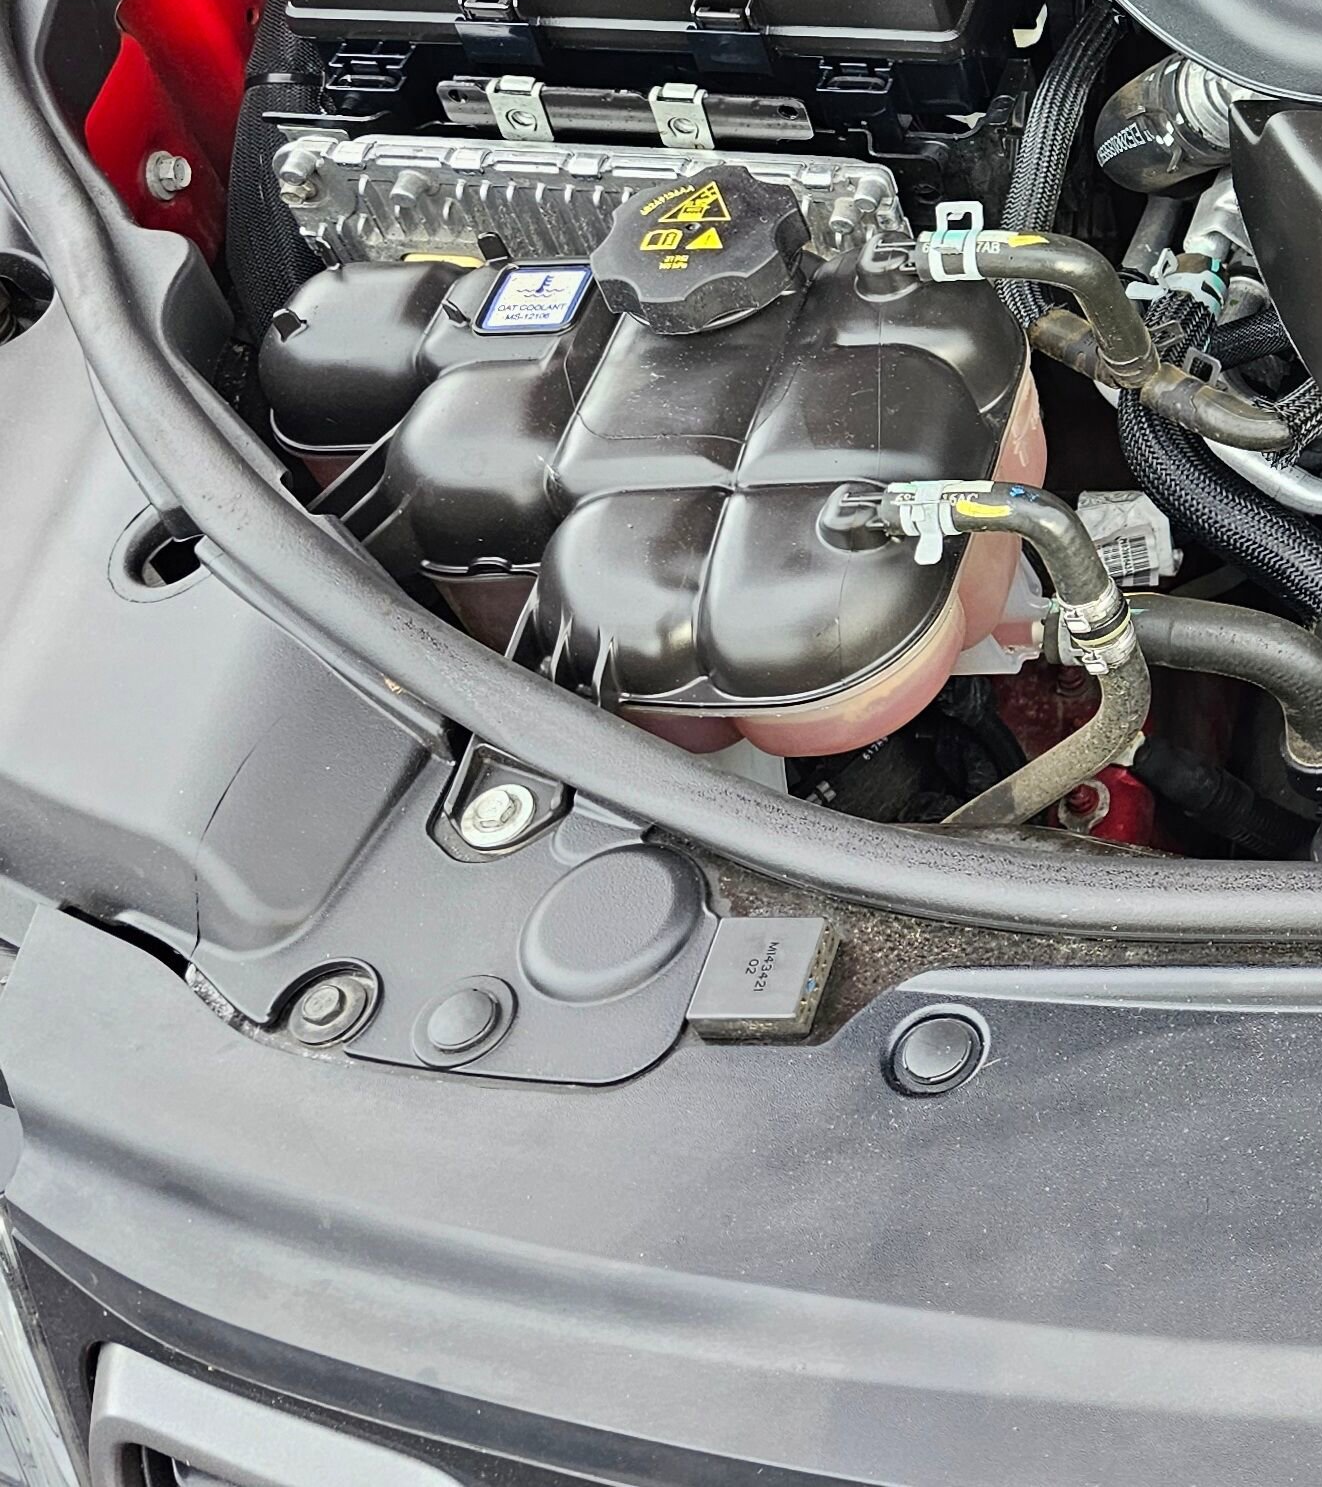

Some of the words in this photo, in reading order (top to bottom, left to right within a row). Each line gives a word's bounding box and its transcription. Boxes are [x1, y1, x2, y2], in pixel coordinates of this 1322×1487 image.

[497, 304, 518, 312] OAT
[519, 303, 566, 311] COOLANT
[745, 959, 760, 975] 02
